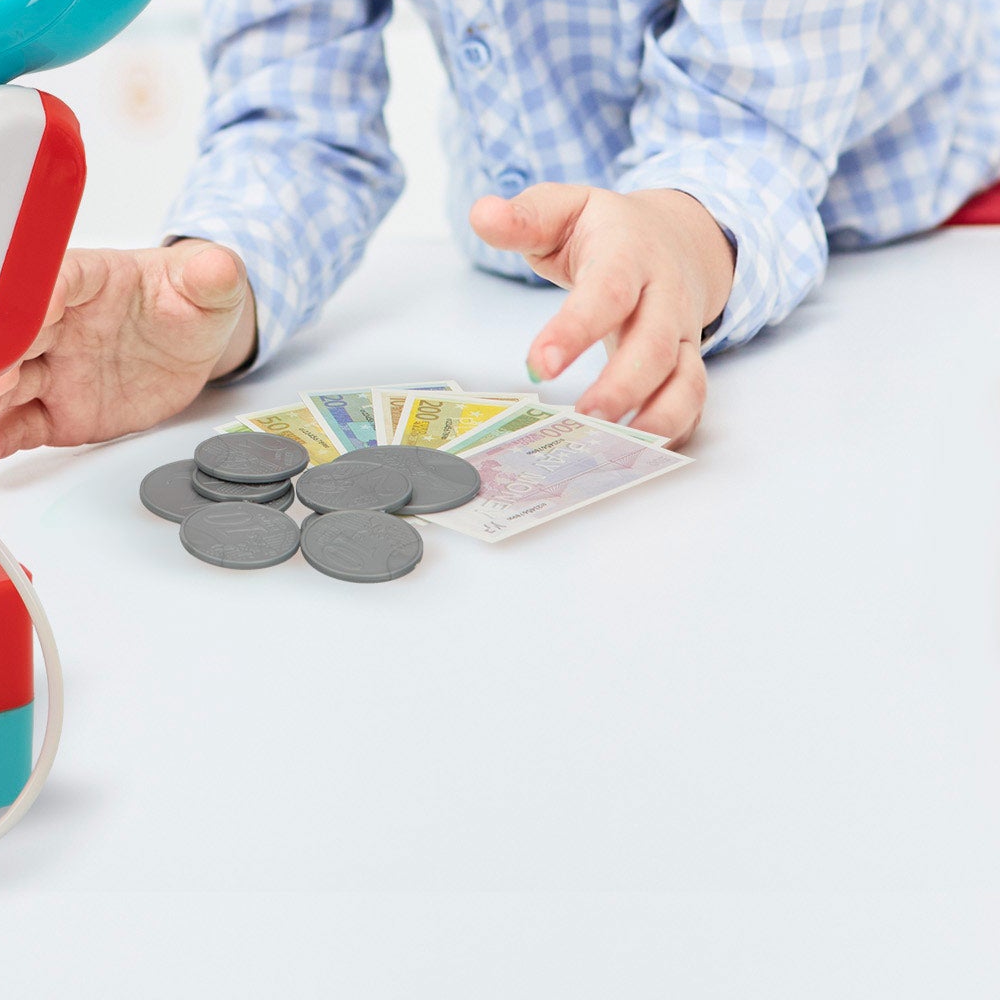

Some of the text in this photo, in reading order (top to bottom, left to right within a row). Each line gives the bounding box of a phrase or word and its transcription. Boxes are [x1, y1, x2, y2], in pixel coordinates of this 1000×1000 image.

[319, 394, 348, 408] 20
[415, 400, 444, 421] 200
[251, 416, 290, 431] 50
[541, 418, 585, 438] 500
